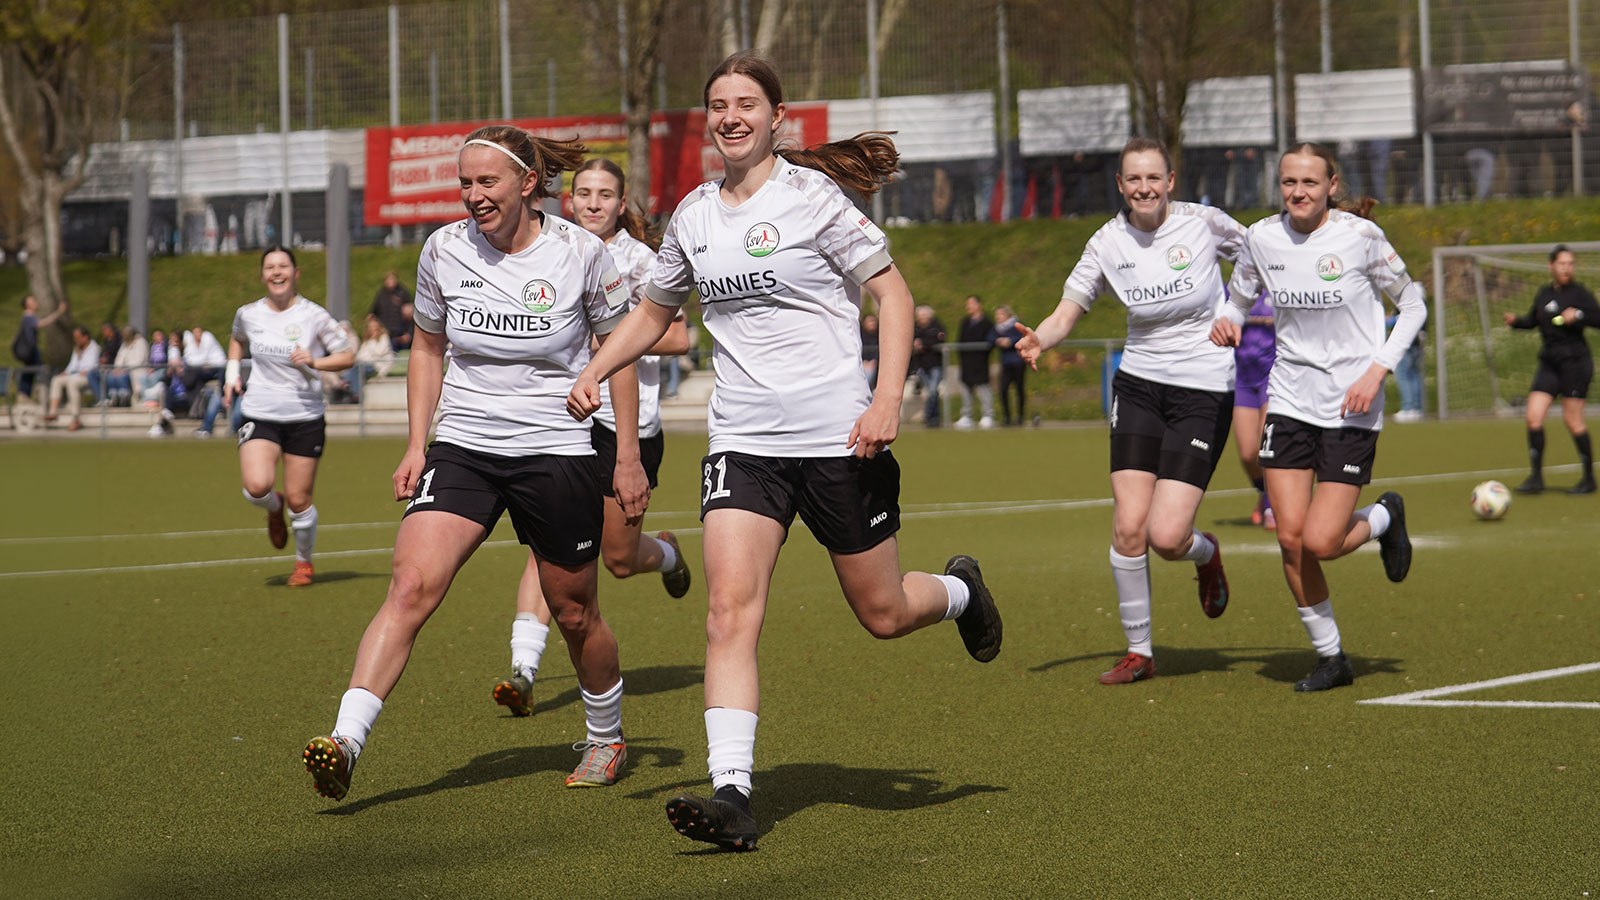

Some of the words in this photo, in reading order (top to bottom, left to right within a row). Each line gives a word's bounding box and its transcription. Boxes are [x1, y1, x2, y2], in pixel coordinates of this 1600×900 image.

[1117, 262, 1136, 270] JAKO
[460, 280, 483, 289] JAKO
[1124, 276, 1194, 302] TÖNNIES
[1271, 288, 1343, 305] TÖNNIES
[459, 307, 551, 332] TÖNNIES
[1190, 438, 1209, 450] JAKO
[1343, 464, 1360, 474] JAKO
[702, 455, 731, 506] 31
[870, 511, 888, 527] JAKO
[577, 540, 593, 550] JAKO
